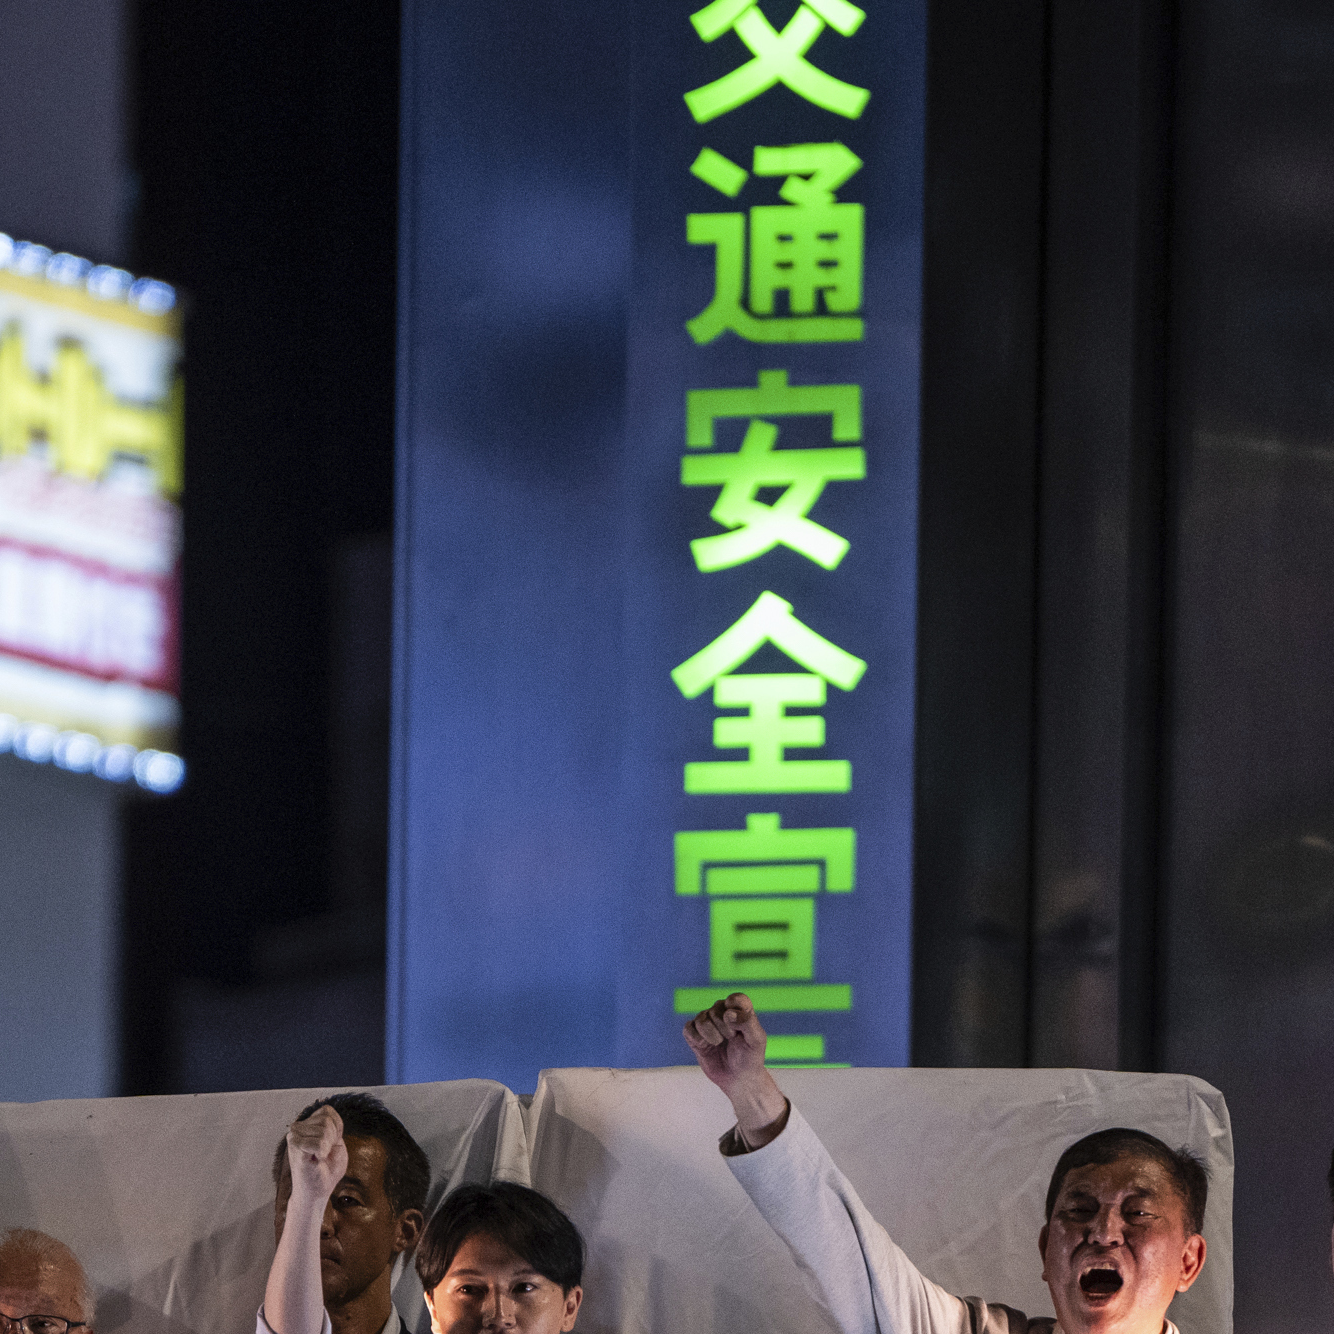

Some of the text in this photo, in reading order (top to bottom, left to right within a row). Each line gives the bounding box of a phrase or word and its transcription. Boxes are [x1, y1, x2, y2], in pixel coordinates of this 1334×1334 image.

[672, 0, 868, 1068] 交通安全宣
